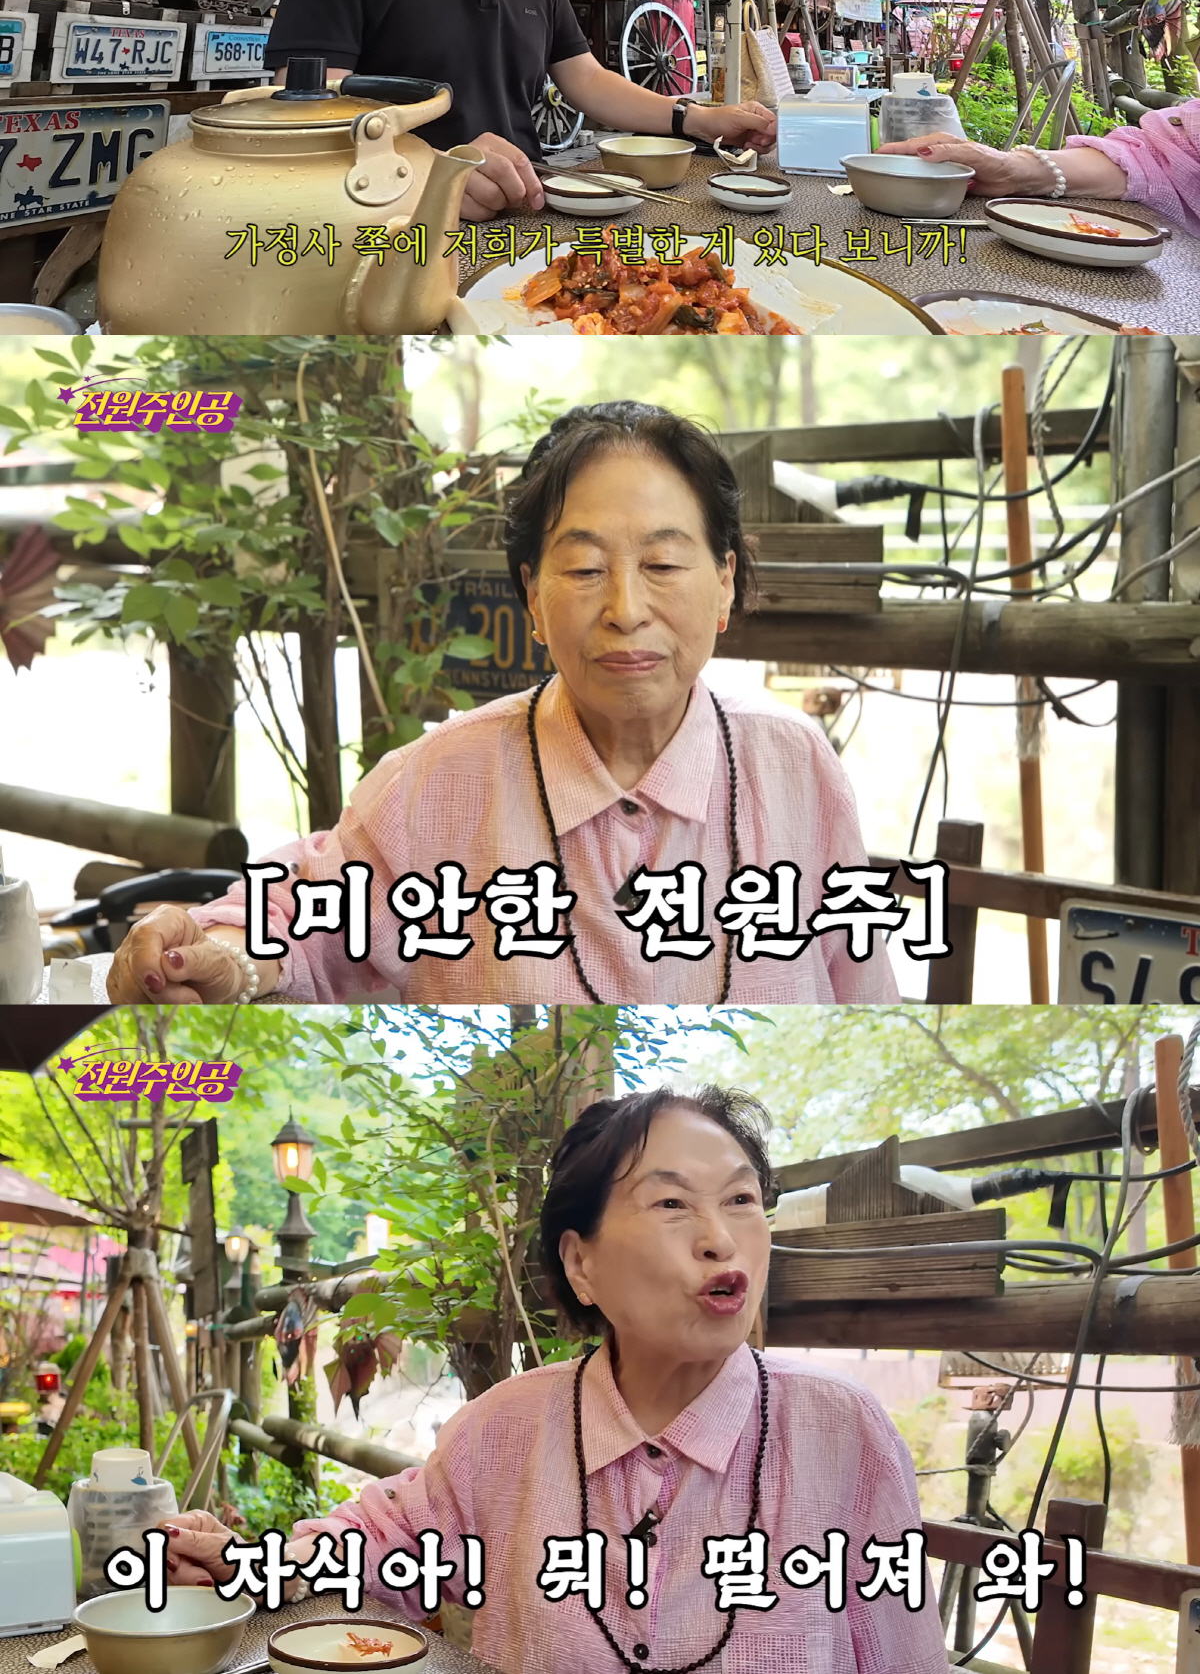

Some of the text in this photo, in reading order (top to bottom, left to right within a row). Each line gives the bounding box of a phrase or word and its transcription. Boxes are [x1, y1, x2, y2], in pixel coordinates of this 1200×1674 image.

[110, 28, 145, 38] TEXAS
[0, 111, 81, 134] EXAS
[24, 206, 53, 216] STAR
[59, 200, 90, 210] STATE
